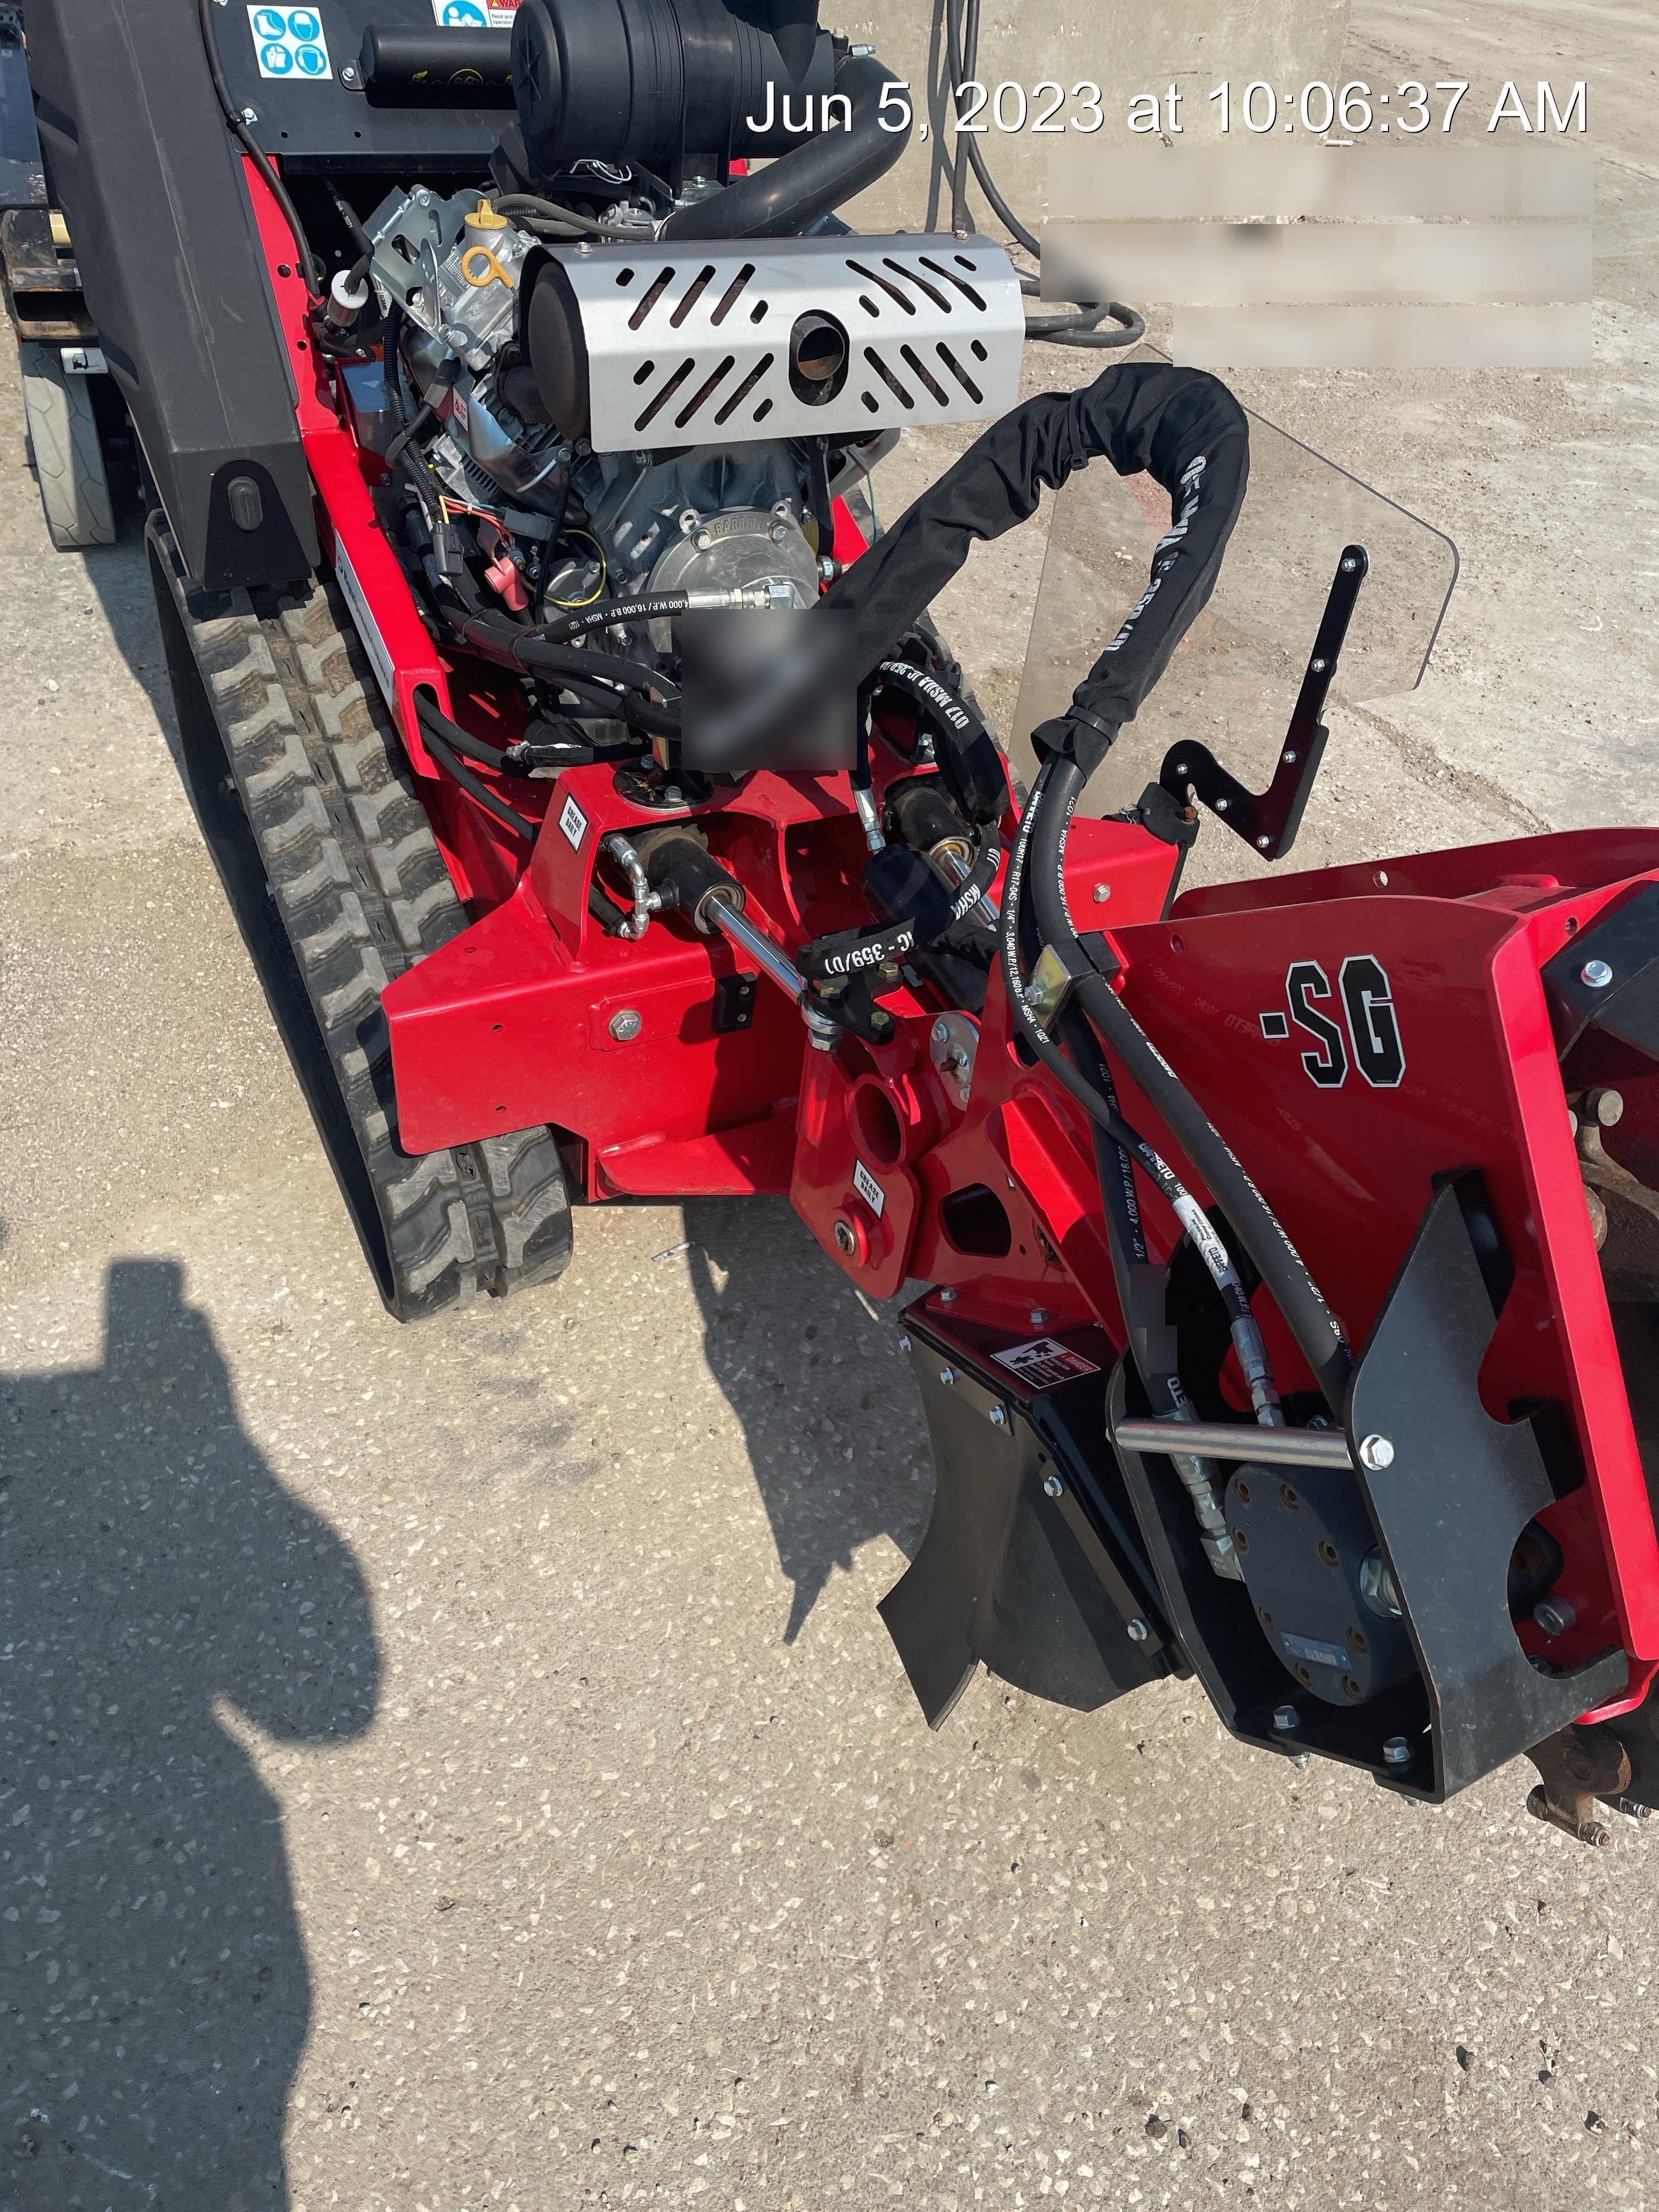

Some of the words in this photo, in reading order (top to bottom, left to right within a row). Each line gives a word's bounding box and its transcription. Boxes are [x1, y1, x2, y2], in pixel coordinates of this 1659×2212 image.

[622, 603, 647, 614] 16,000
[668, 599, 689, 610] 4,000
[584, 612, 604, 624] MSHA
[565, 817, 578, 837] DAILY
[567, 806, 583, 831] GREASE
[1058, 829, 1069, 855] MSHA
[950, 883, 981, 921] MSHA
[825, 942, 885, 975] 359/01
[1008, 871, 1022, 901] R17-04S
[1020, 1005, 1037, 1028] MSHA
[859, 1170, 879, 1200] GREASE
[860, 1181, 876, 1203] DAILY
[1208, 1246, 1228, 1274] BARRETO
